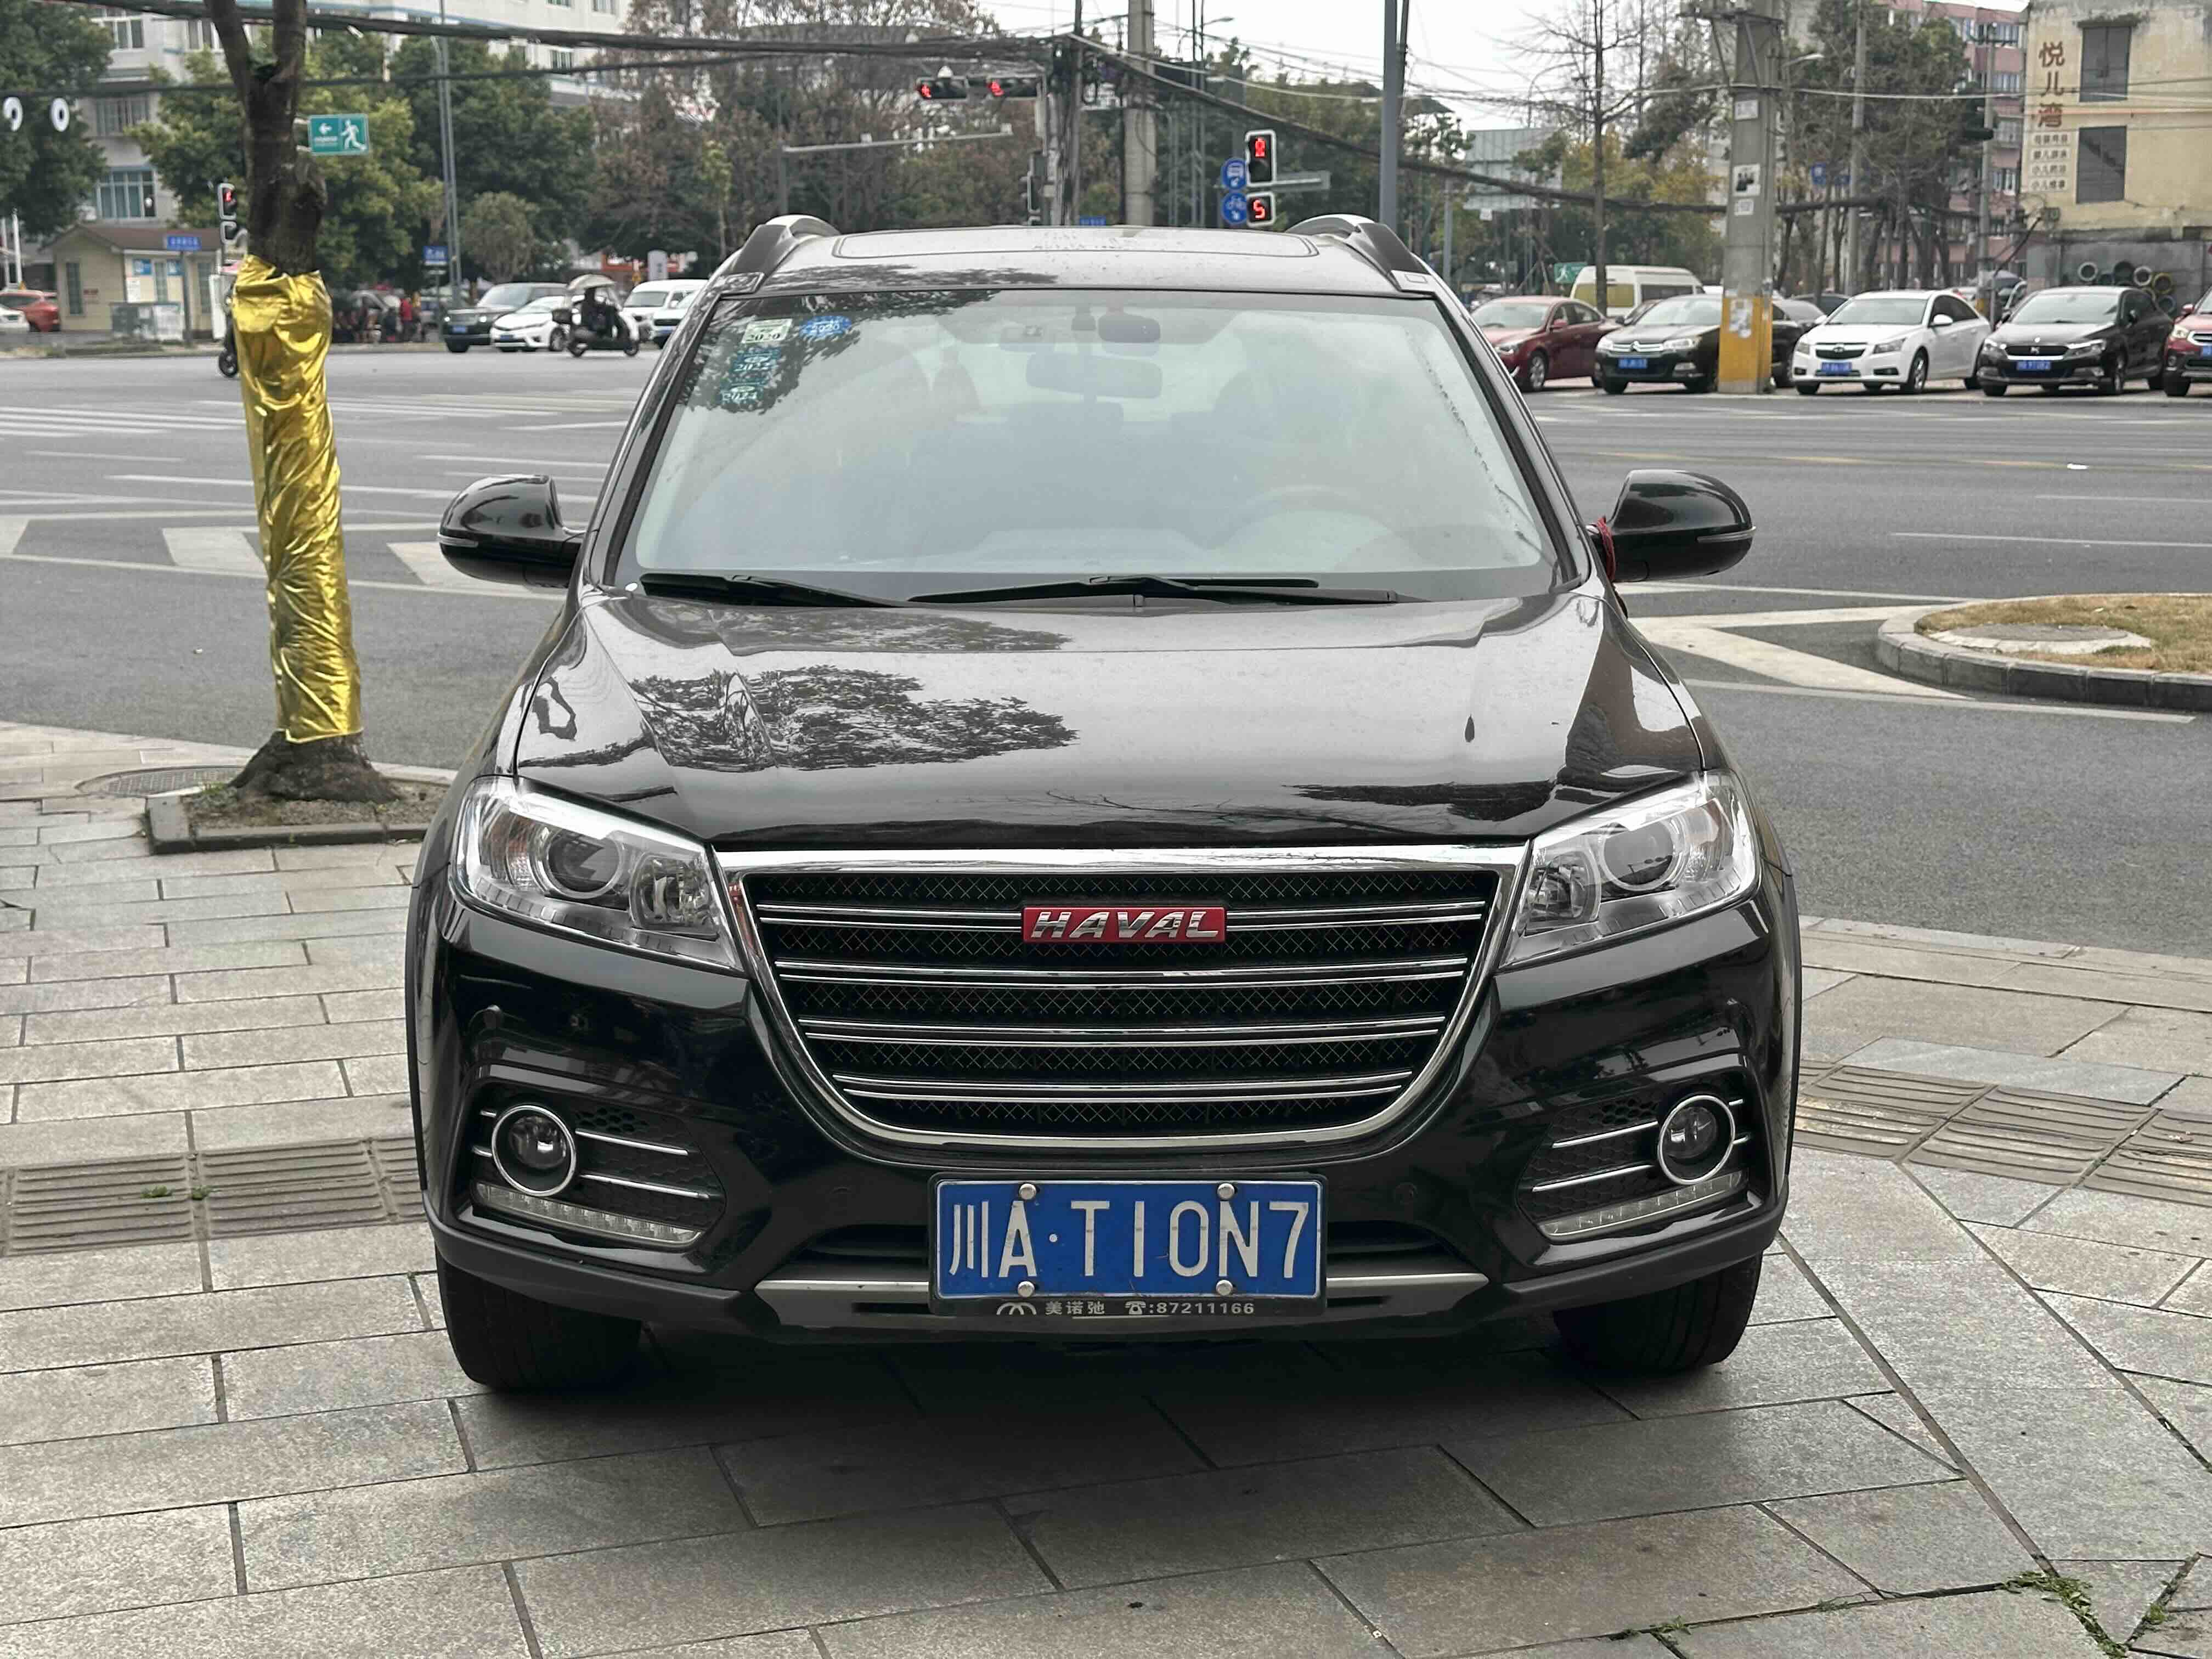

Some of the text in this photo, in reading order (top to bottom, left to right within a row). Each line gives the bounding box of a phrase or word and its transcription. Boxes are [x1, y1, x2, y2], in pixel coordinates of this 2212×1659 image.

[2039, 41, 2065, 127] 悦儿湾
[1031, 911, 1218, 938] HAVAL
[1045, 1301, 1105, 1315] 美诺弛
